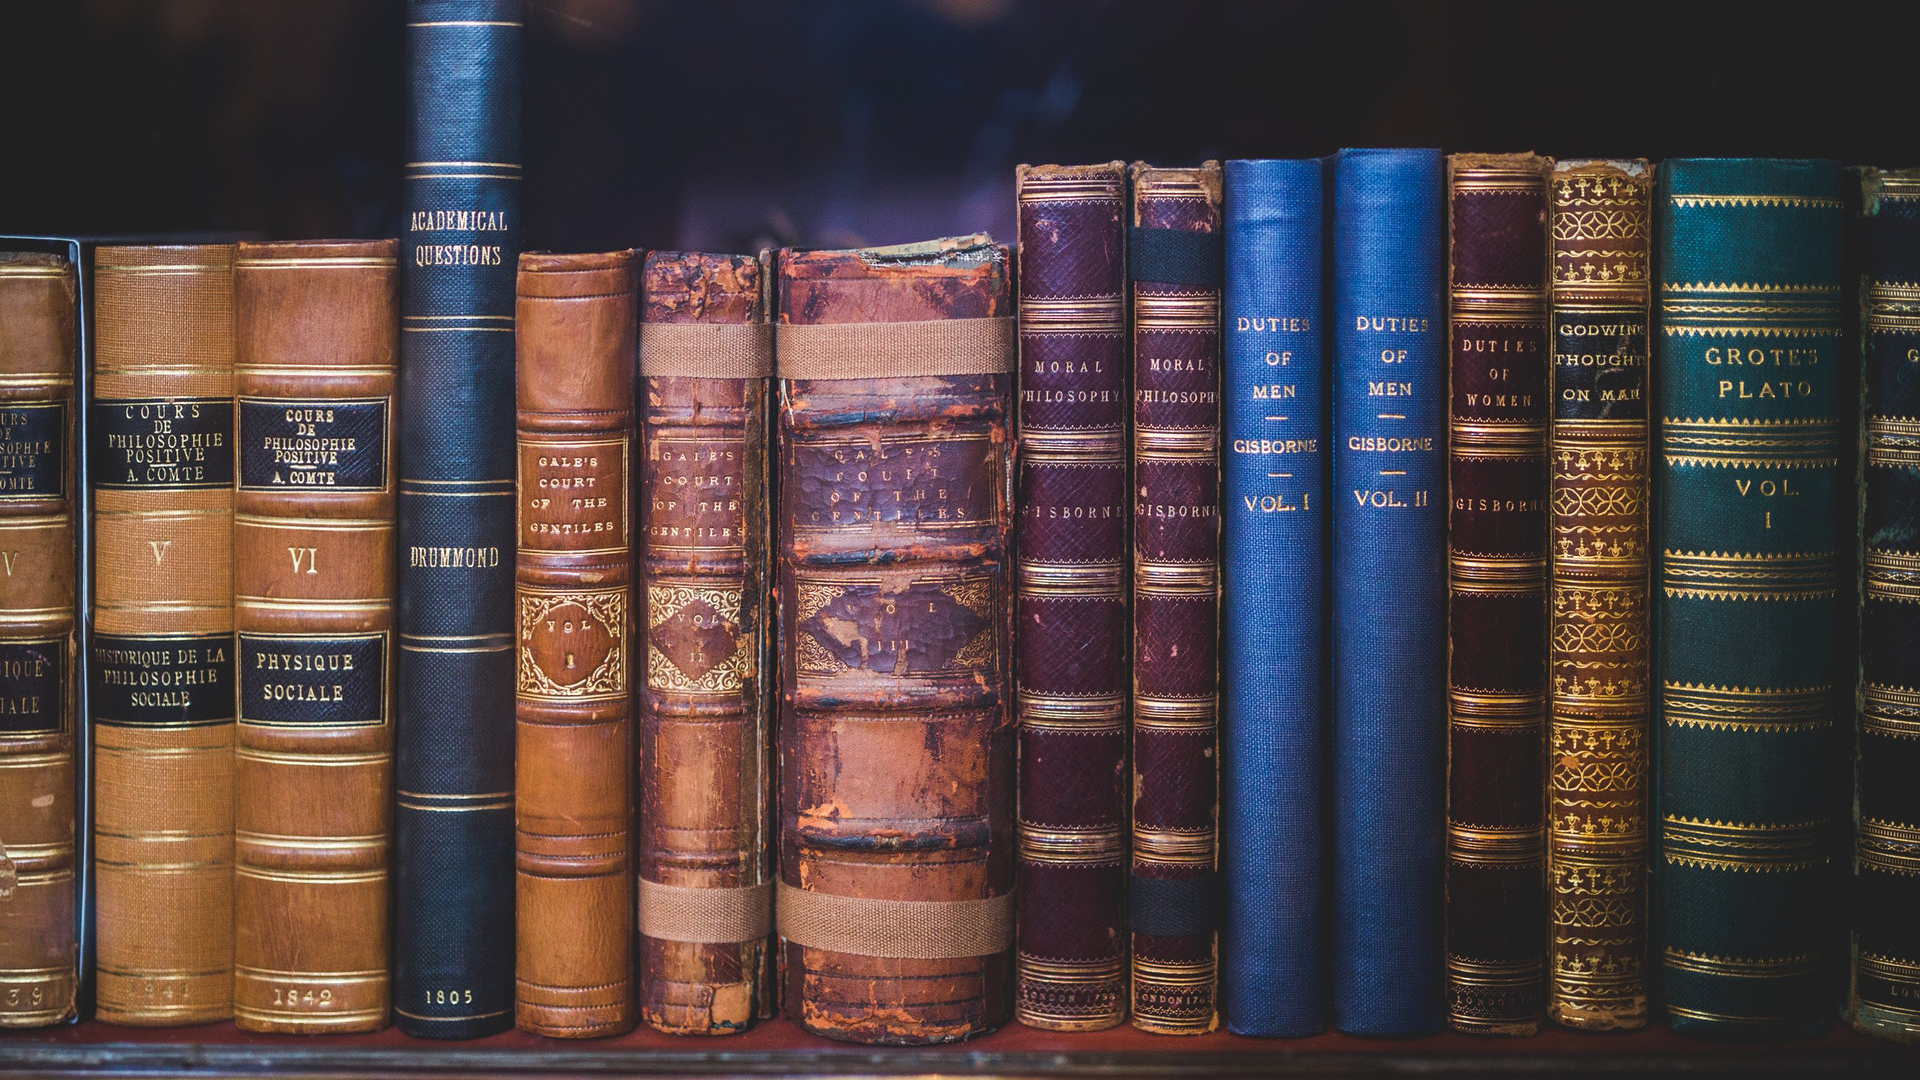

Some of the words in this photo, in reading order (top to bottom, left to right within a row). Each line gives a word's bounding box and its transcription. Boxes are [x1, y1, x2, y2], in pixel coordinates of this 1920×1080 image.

[411, 210, 508, 231] ACADEMICAL
[416, 245, 501, 267] QUESTIONS
[1238, 317, 1310, 332] DUTIES
[1356, 316, 1429, 332] DUTIES
[1463, 340, 1537, 352] DUTIES
[1266, 351, 1292, 365] OF
[1381, 349, 1407, 363] OF
[1705, 348, 1818, 366] GROTE'S
[1035, 361, 1102, 373] MORAL
[1150, 358, 1204, 371] MORAL
[1489, 368, 1510, 381] OF
[1253, 385, 1295, 399] MEN
[1369, 381, 1412, 396] MEN
[1563, 389, 1590, 402] ON
[1600, 389, 1640, 401] MAN
[1719, 381, 1812, 399] PLATO
[1021, 390, 1120, 402] PHILOSOPHY
[1136, 390, 1218, 403] PHILOSOPH
[1466, 394, 1531, 407] WOMEN
[126, 405, 200, 419] COURS
[285, 409, 334, 423] COURS
[154, 420, 172, 433] DE
[297, 423, 315, 436] DE
[109, 433, 223, 448] PHILOSOPHIE
[263, 437, 356, 451] PHILOSOPHIE
[1234, 439, 1317, 453] GISBORNE
[1349, 436, 1433, 451] GISBORNE
[126, 448, 204, 463] POSITIVE
[274, 450, 338, 464] POSITIVE
[539, 457, 598, 468] GALE'S
[127, 468, 139, 482] A.
[146, 466, 204, 481] COMTE
[272, 471, 285, 484] A.
[290, 471, 335, 485] COMTE
[664, 476, 733, 486] COURT
[539, 477, 596, 488] COURT
[1736, 479, 1800, 497] VOL.
[831, 492, 862, 502] OF
[893, 489, 947, 502] THE
[1244, 495, 1295, 512] VOL.
[1303, 493, 1309, 510] I
[1354, 489, 1407, 508] VOL.
[1415, 490, 1428, 507] II
[531, 499, 551, 510] OF
[572, 498, 607, 509] THE
[656, 501, 677, 511] OF
[699, 501, 737, 511] THE
[530, 521, 614, 535] GENTILES
[1765, 512, 1772, 530] I
[651, 526, 744, 537] GENTILES
[150, 541, 171, 565] V
[411, 547, 499, 568] DRUMMOND
[288, 547, 318, 574] VI
[677, 614, 719, 625] VOL
[547, 620, 591, 634] VOL
[95, 648, 170, 668] HISTORIQUE
[178, 649, 197, 664] DE
[207, 648, 225, 663] LA
[257, 653, 353, 673] PHYSIQUE
[690, 652, 704, 662] II
[104, 668, 217, 686] PHILOSOPHIE
[131, 691, 191, 707] SOCIALE
[263, 684, 344, 704] SOCIALE
[273, 989, 332, 1007] 1842
[426, 990, 472, 1005] 1805
